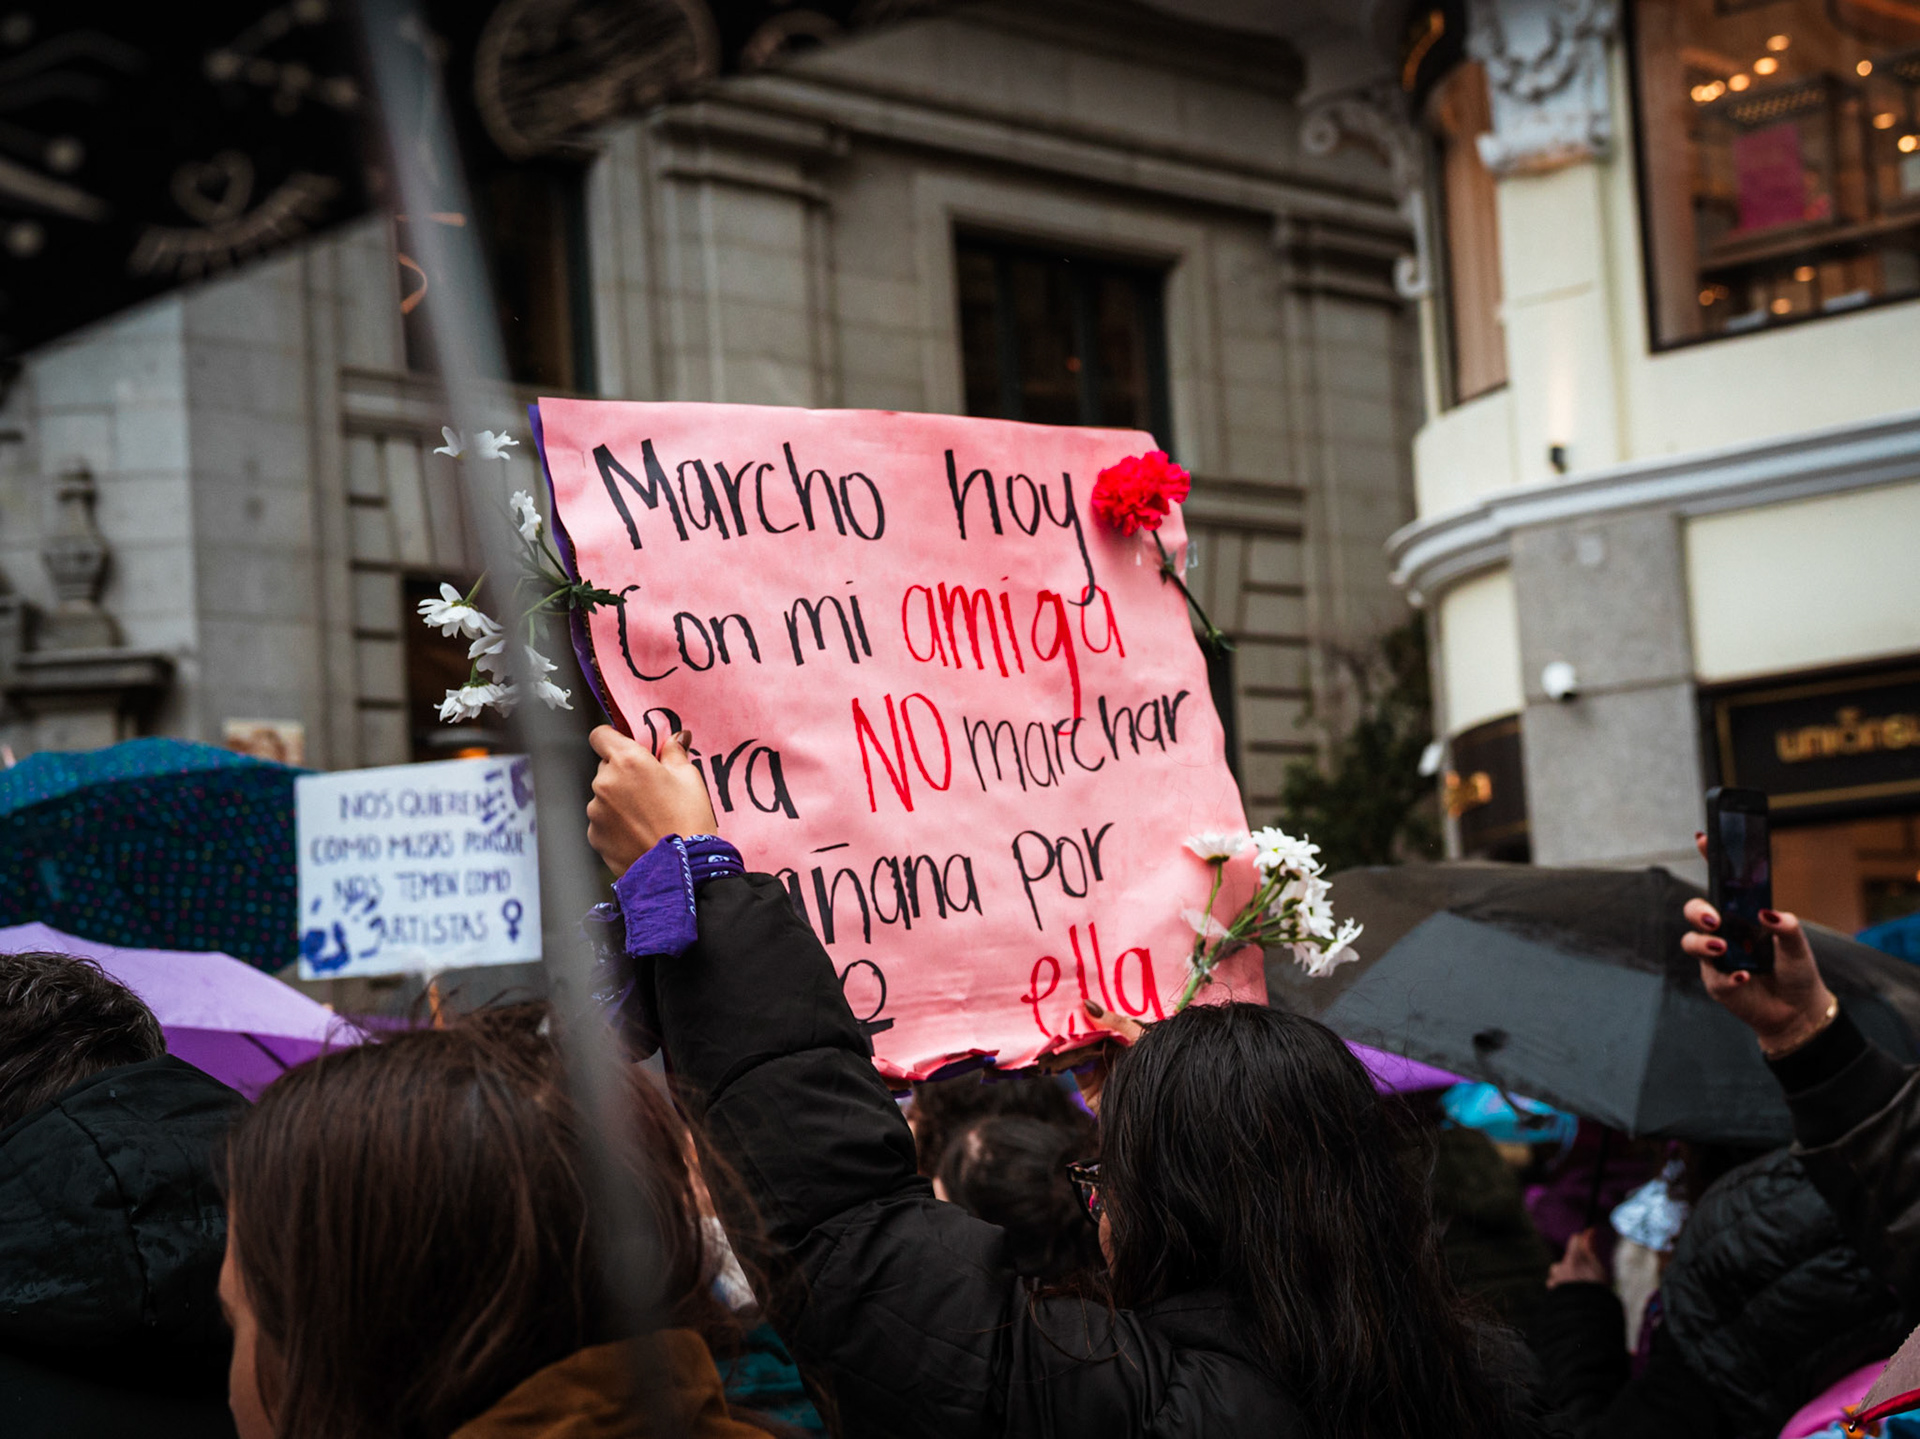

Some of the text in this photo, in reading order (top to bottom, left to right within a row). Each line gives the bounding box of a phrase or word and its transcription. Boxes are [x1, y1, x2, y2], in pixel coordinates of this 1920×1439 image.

[593, 438, 1095, 606] Marcho hoy
[617, 576, 1126, 735] Con mi amiga
[339, 792, 394, 821] NOS
[852, 693, 951, 812] NO
[963, 690, 1190, 792] marchar
[1012, 822, 1114, 931] por
[1021, 922, 1165, 1038] ella
